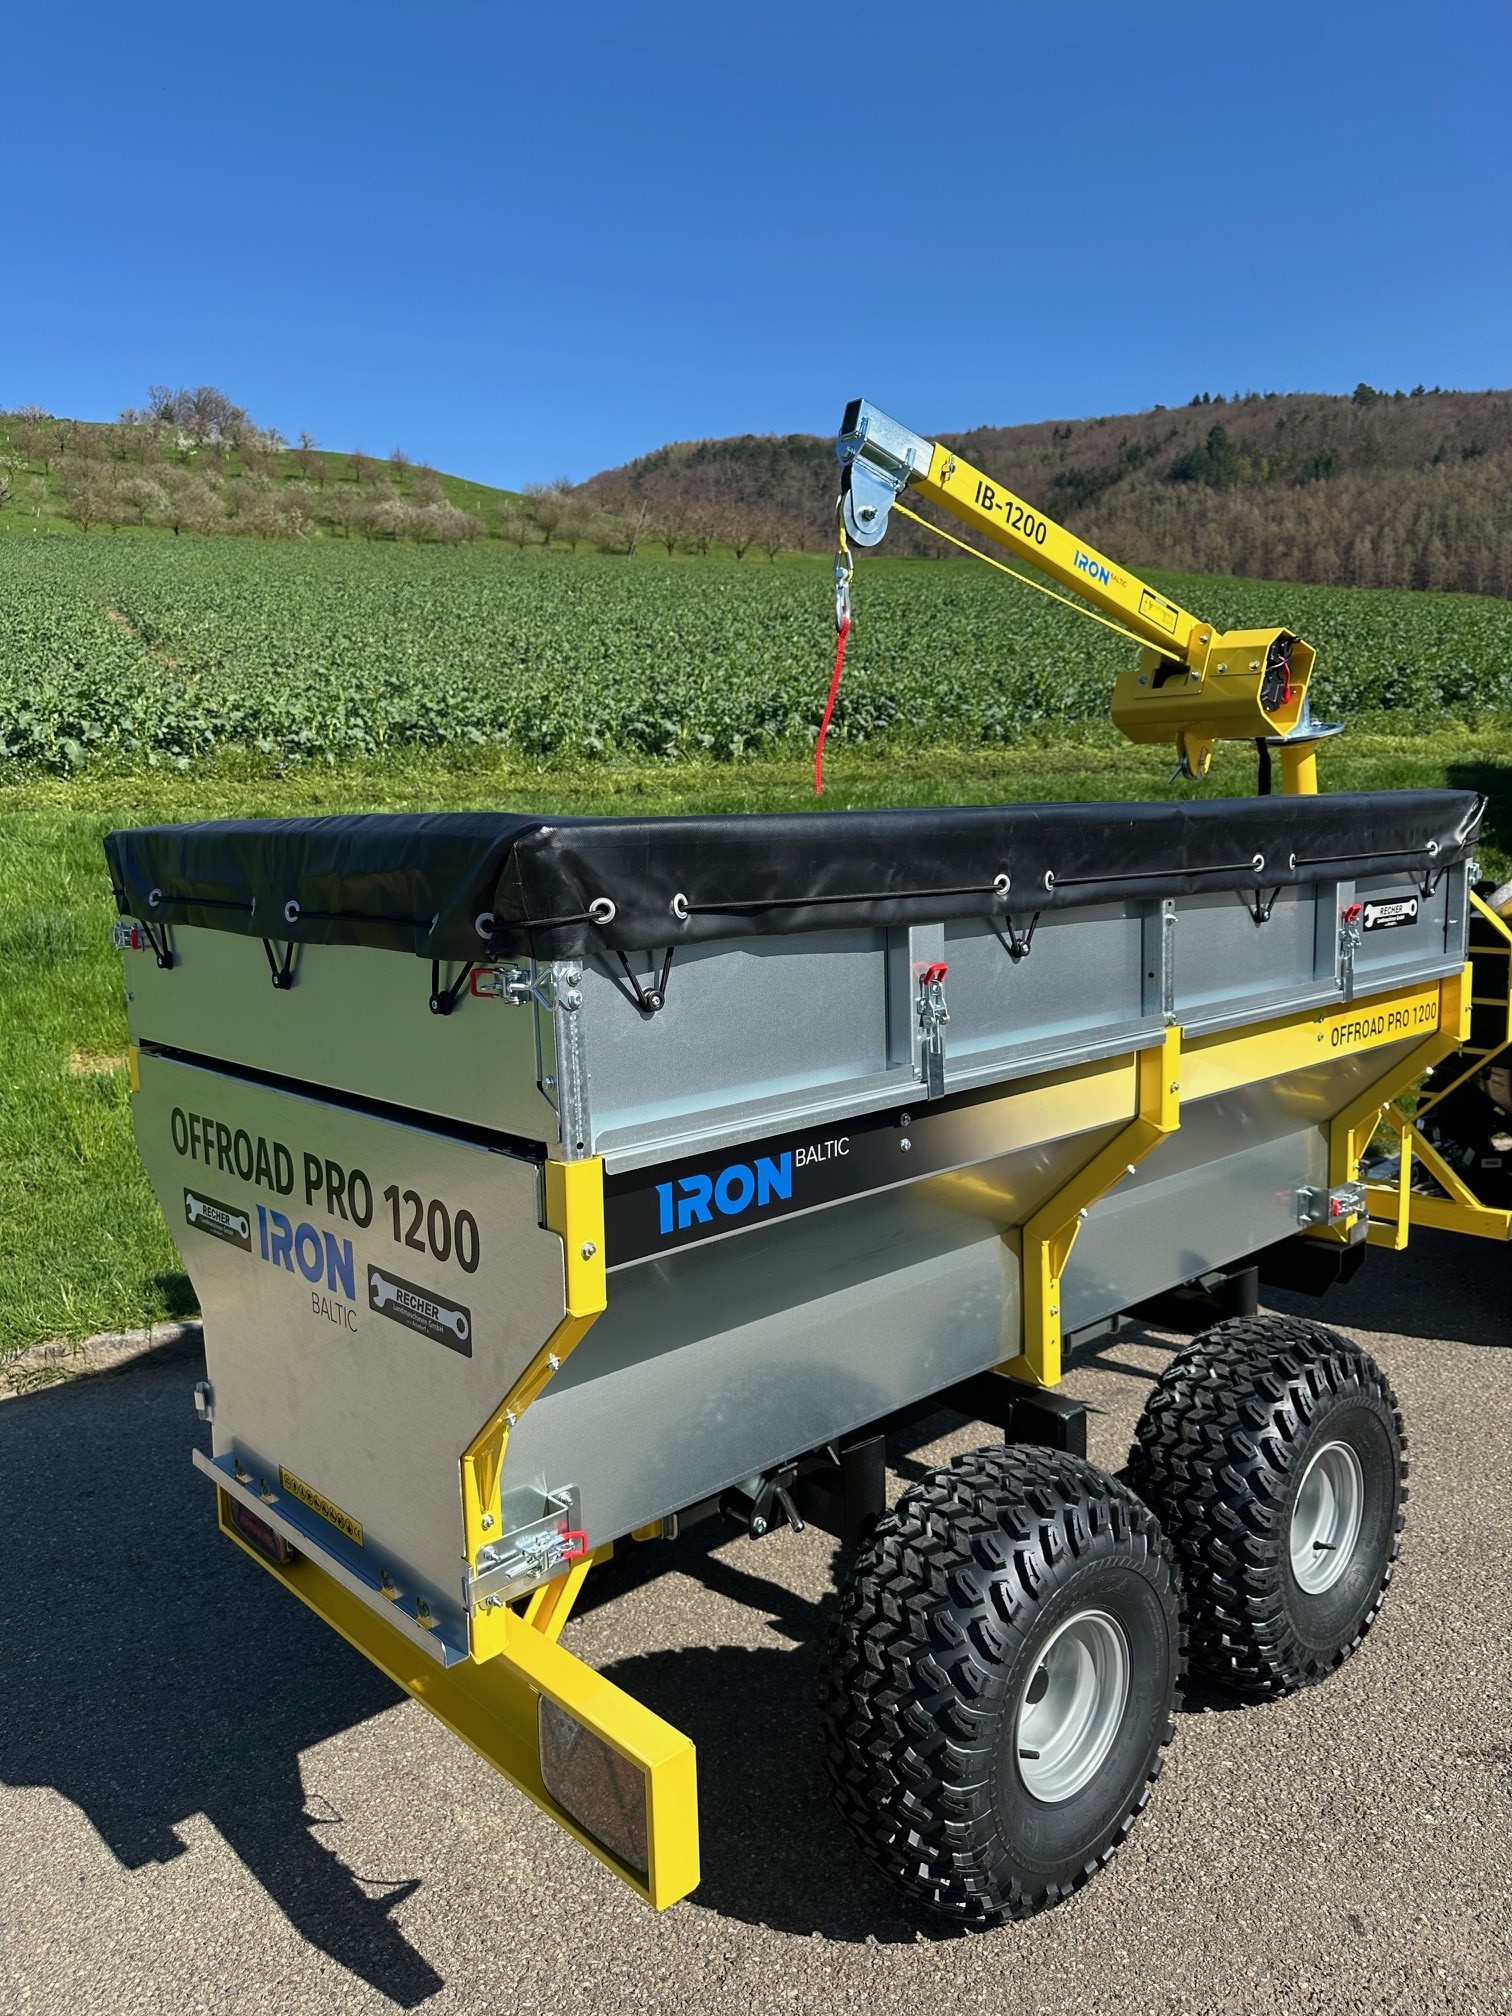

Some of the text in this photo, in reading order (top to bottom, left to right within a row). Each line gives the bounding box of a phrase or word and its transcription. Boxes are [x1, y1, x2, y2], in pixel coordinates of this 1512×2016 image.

[974, 480, 1047, 545] IB-1200
[1074, 549, 1110, 586] IRON
[1380, 905, 1403, 915] RECHER
[1331, 1001, 1437, 1047] OFFROAD PRO 1200
[171, 1107, 480, 1274] OFFROAD PRO 1200
[654, 1137, 850, 1235] IRON BALTIC
[203, 1205, 231, 1225] RECHER
[256, 1204, 356, 1301] IRON
[311, 1292, 358, 1333] BALTIC
[396, 1289, 439, 1320] RECHER
